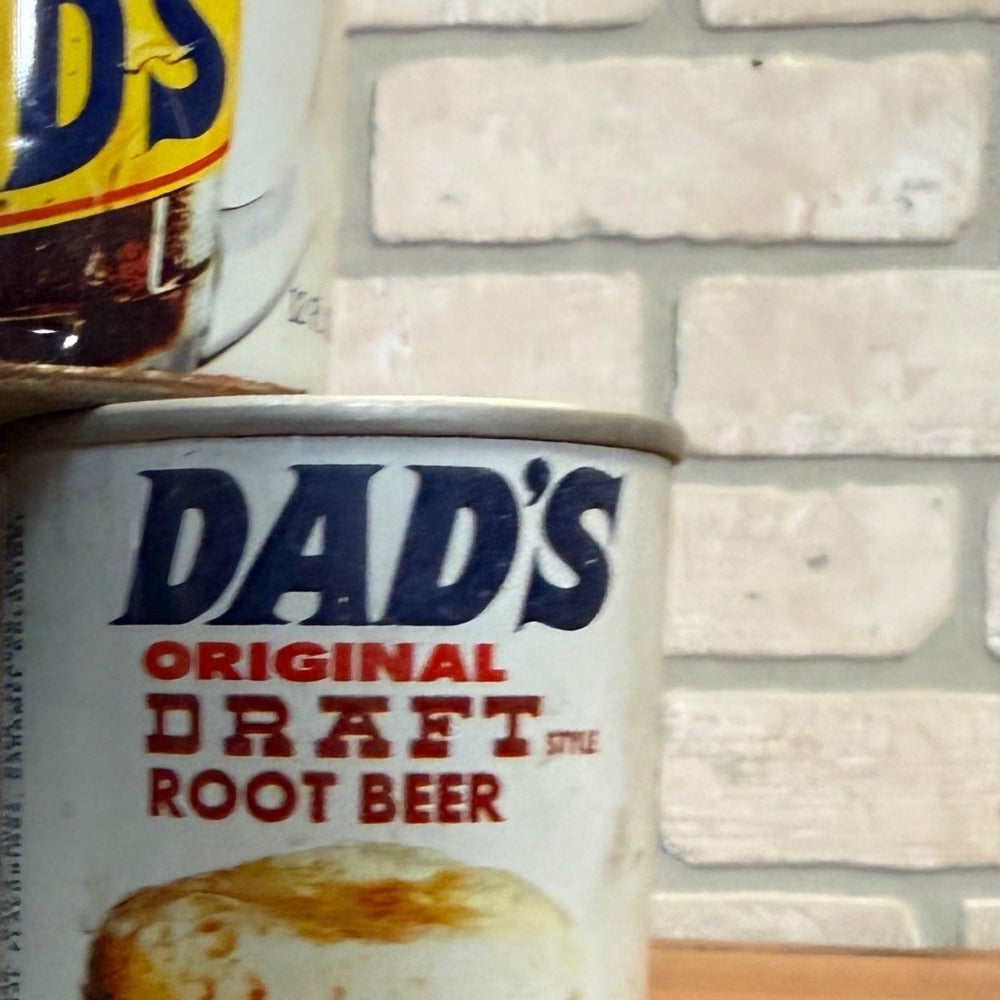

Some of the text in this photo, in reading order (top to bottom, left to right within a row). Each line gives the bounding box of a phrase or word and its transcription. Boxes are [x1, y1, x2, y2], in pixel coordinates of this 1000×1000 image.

[108, 457, 626, 632] DAD'S
[143, 640, 508, 682] ORIGINAL
[145, 694, 601, 759] DRAFT STYLE
[148, 767, 508, 825] ROOT BEER
